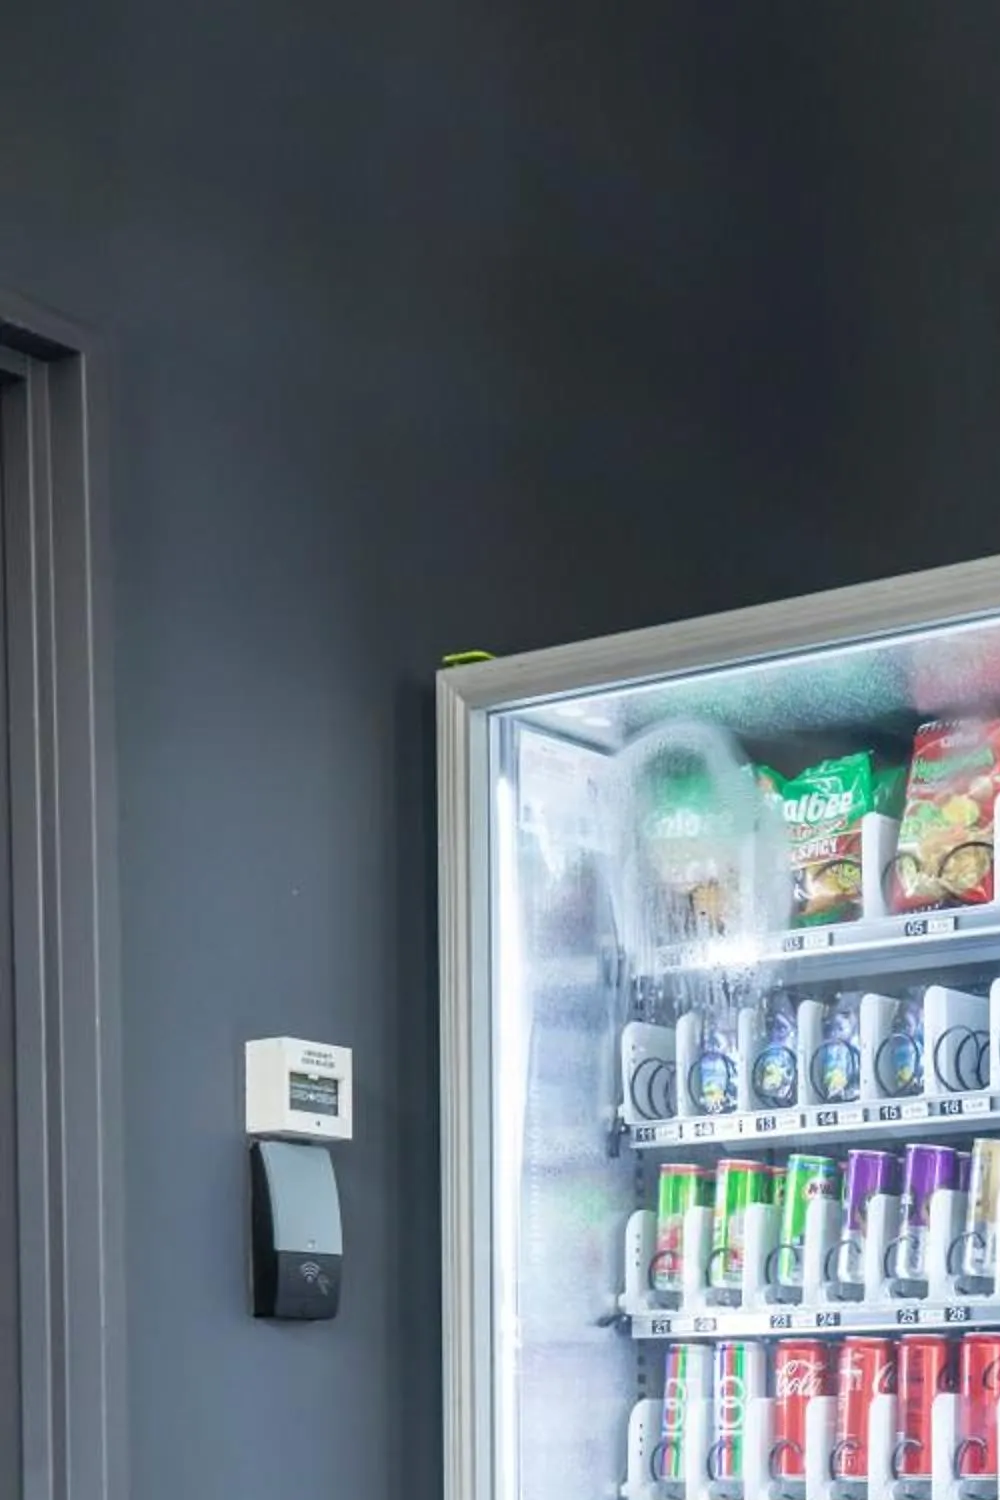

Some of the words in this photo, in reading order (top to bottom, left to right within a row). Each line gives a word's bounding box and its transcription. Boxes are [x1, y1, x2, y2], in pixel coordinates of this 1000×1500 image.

[776, 791, 854, 823] albee
[906, 921, 923, 935] 05
[900, 1311, 915, 1323] 25
[950, 1309, 965, 1321] 26
